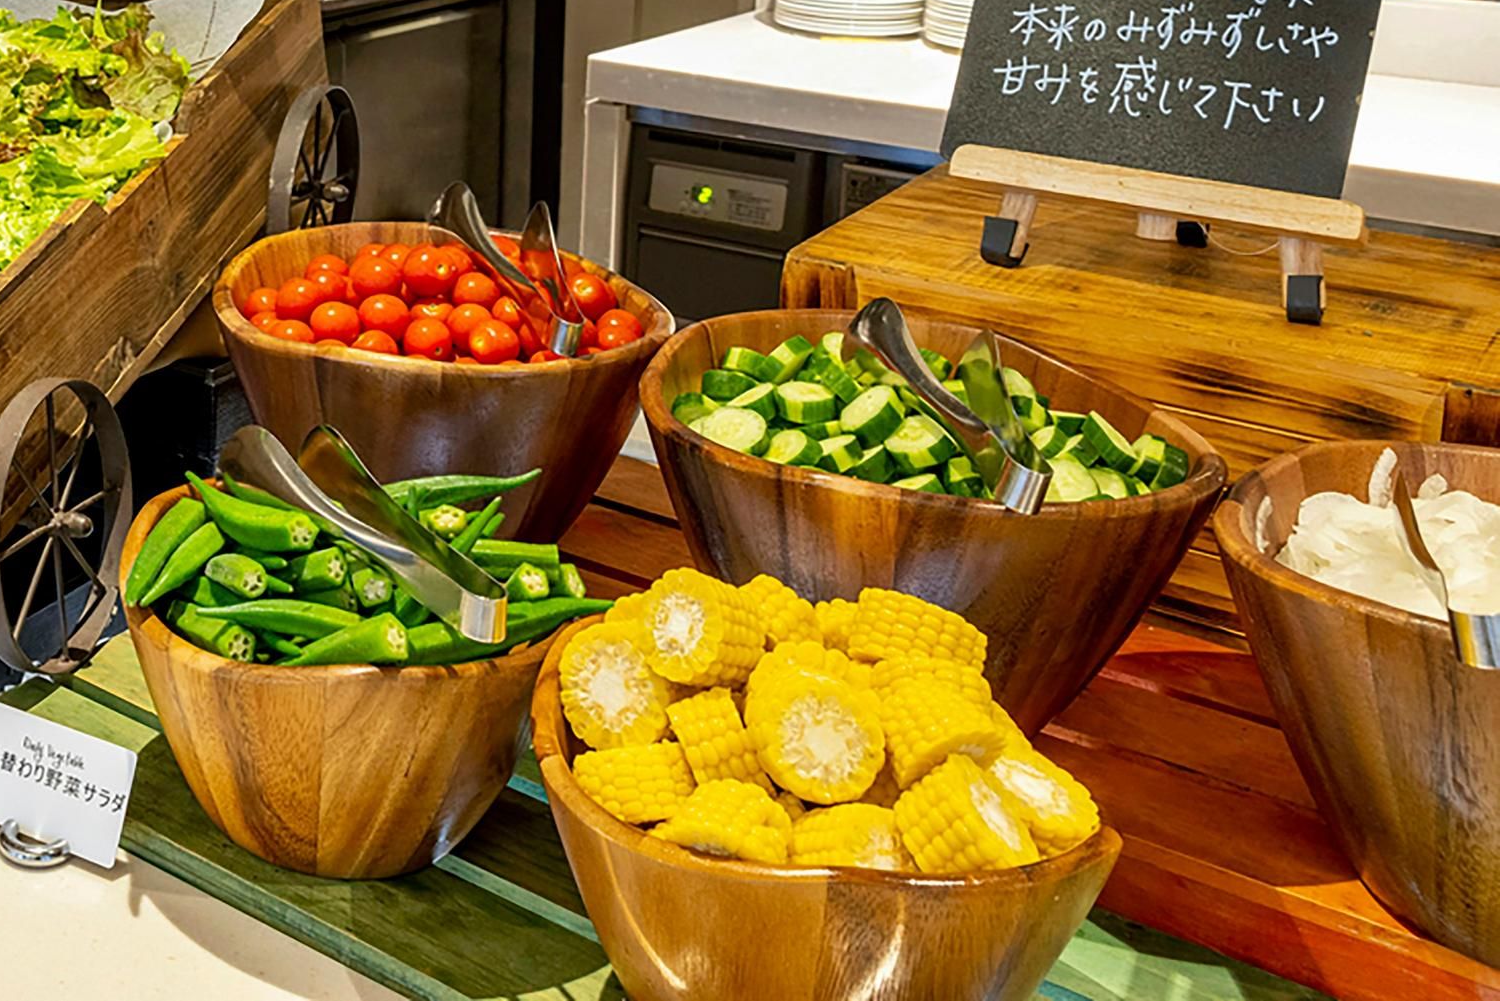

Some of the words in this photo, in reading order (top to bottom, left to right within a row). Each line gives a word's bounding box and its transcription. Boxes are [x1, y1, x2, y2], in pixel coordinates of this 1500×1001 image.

[1009, 1, 1340, 60] 本来のみずみずしさや
[992, 55, 1325, 131] 甘みを感じて下さい
